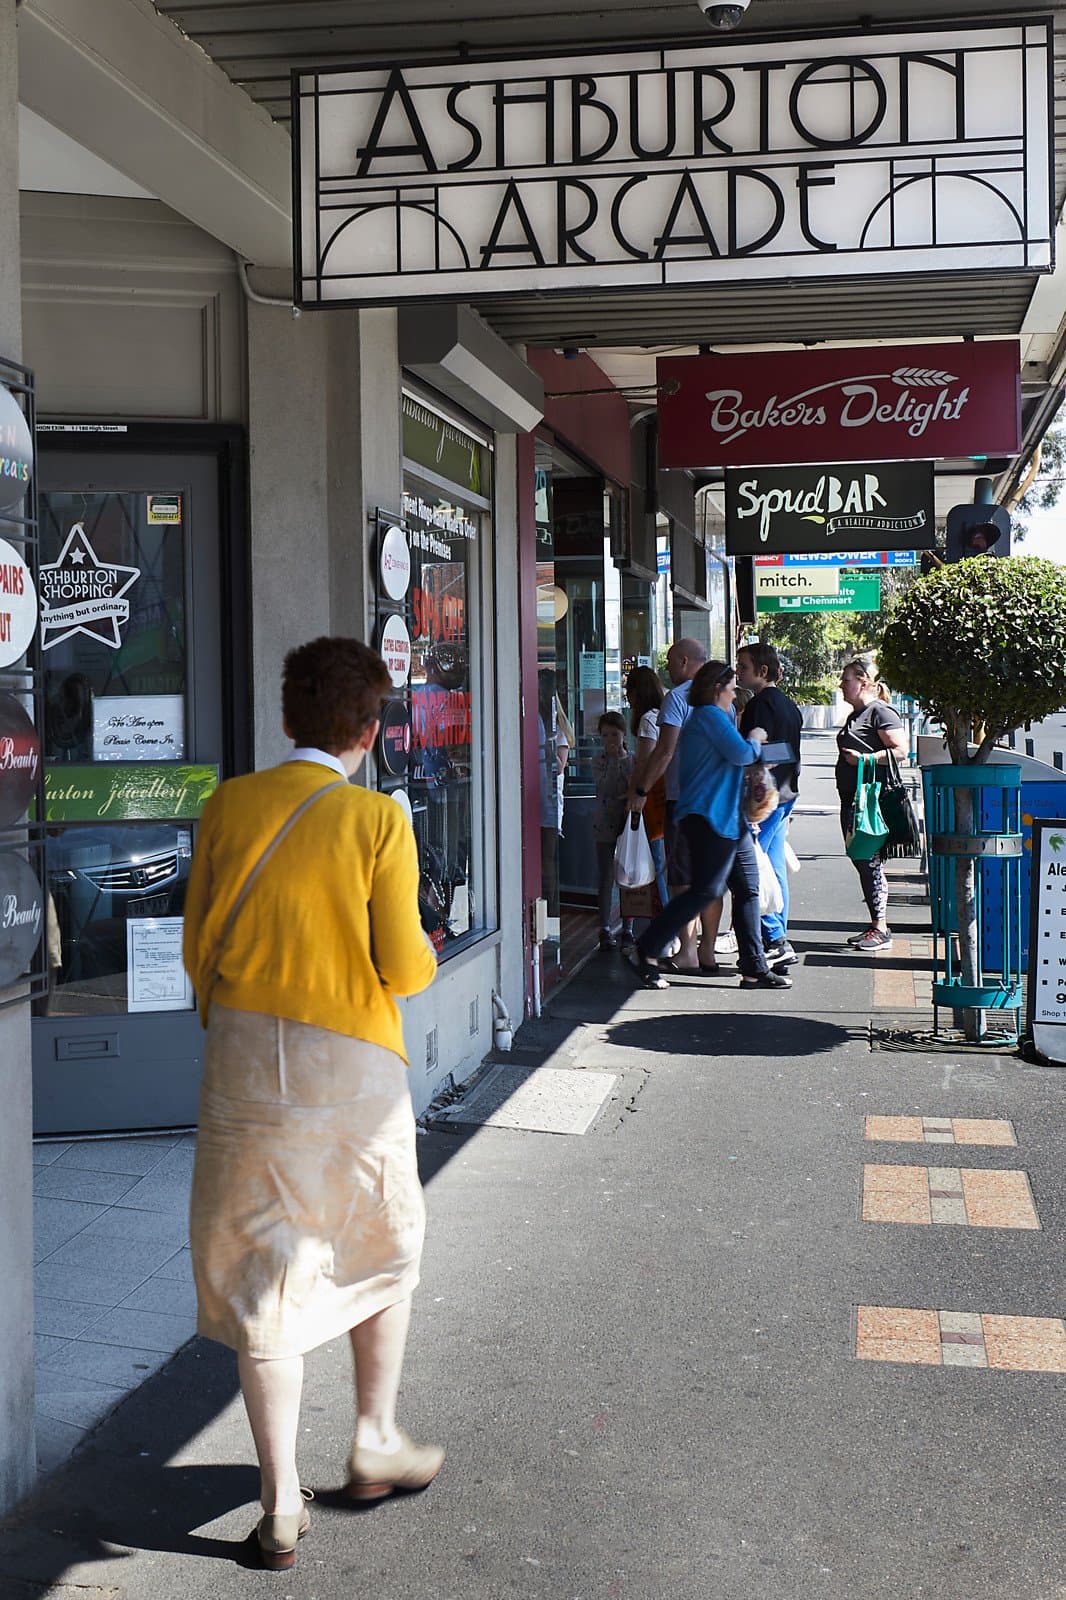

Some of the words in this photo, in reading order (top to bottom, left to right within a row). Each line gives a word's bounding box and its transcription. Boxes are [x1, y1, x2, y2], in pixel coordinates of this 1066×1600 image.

[356, 52, 965, 177] ASHBURTON
[480, 162, 837, 268] ARCADE
[705, 389, 827, 440] Bakers
[840, 385, 970, 437] Delight
[877, 519, 918, 529] ADDICTION
[789, 551, 877, 561] NEWSPOWER
[40, 570, 117, 584] ASHBURTON
[760, 573, 812, 587] mitch.
[44, 584, 113, 598] SHOPPING
[803, 596, 852, 605] Chemmart
[76, 608, 90, 617] but
[92, 602, 127, 614] ordinary
[442, 592, 464, 645] OFF
[411, 690, 472, 750] TOREWIDE
[103, 734, 131, 746] Please
[133, 733, 159, 745] Come
[159, 733, 174, 745] In
[0, 737, 38, 779] Beauty
[97, 776, 188, 816] jewellery
[2, 894, 41, 934] Beauty
[1041, 1009, 1061, 1017] Shop
